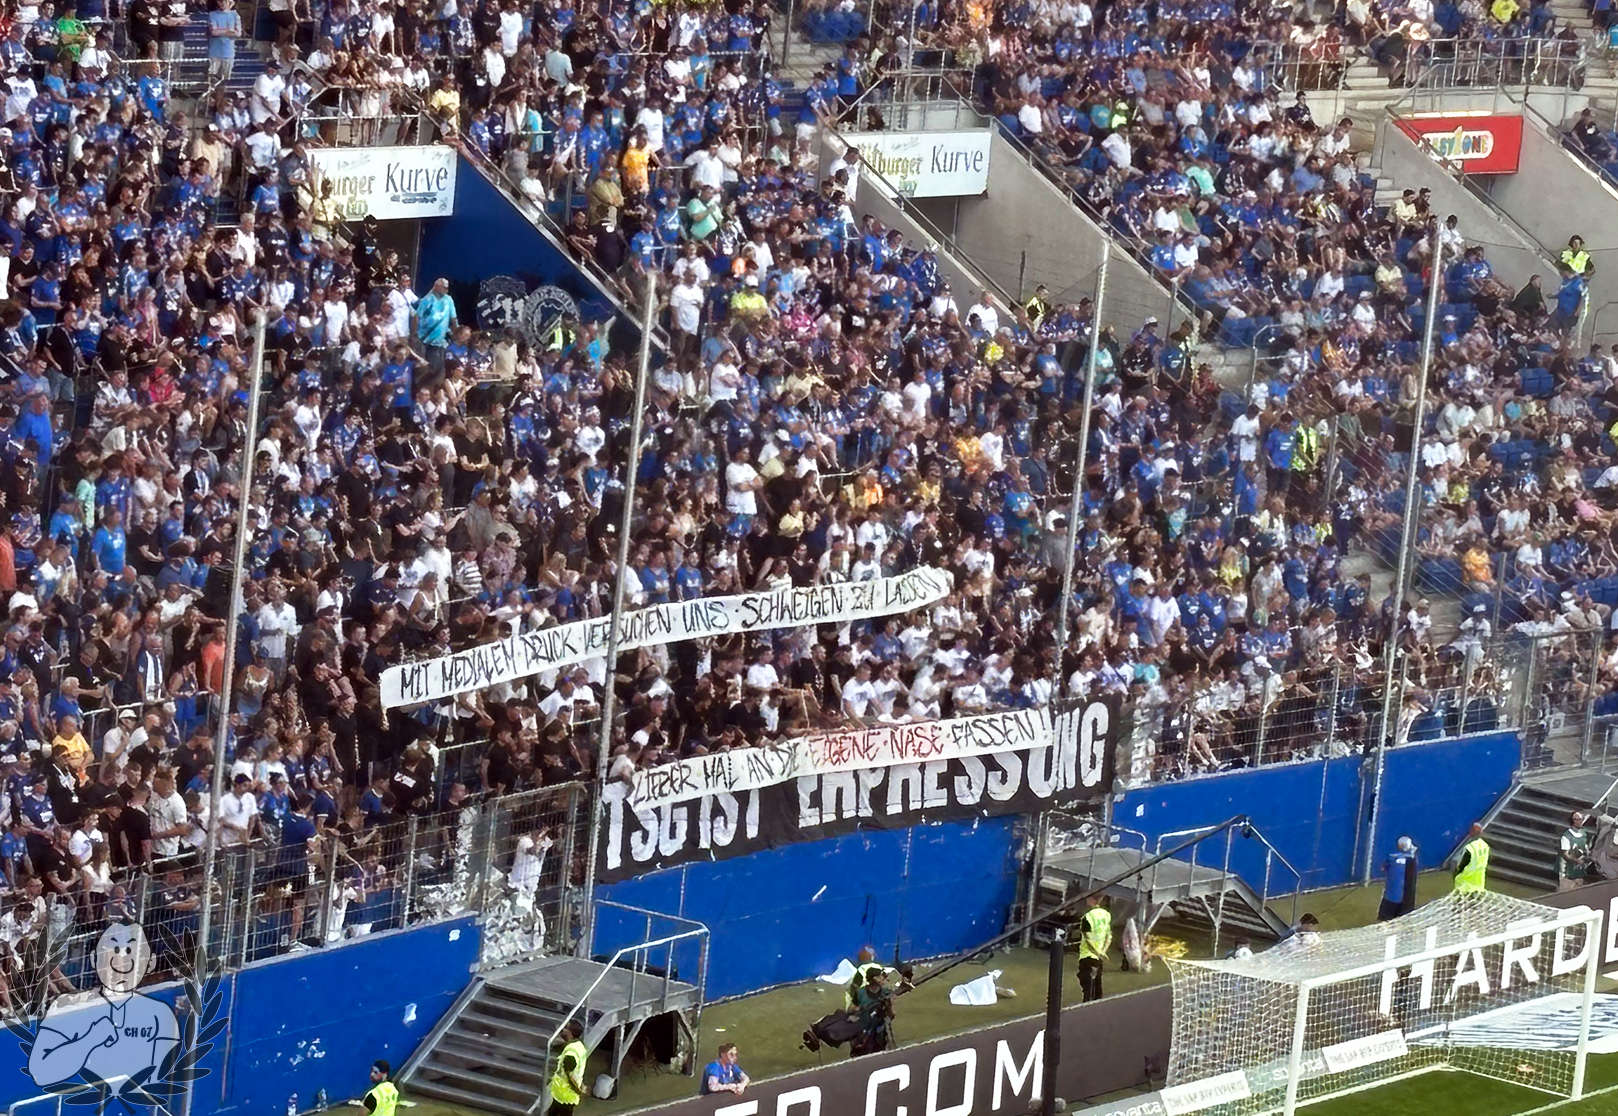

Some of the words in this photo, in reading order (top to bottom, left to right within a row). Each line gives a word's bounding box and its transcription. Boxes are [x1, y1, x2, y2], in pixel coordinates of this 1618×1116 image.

[385, 162, 449, 193] Kurve
[931, 144, 984, 174] Kurve
[400, 662, 430, 700] MIT
[441, 635, 518, 694] MEDIALEM
[519, 627, 579, 670] DRUCK
[681, 600, 730, 633] UNS
[741, 585, 843, 629] SCHWEIGEN
[851, 583, 875, 611] ZU
[632, 763, 699, 805] LIEBER
[703, 755, 740, 790] MAL
[746, 750, 775, 785] AN
[810, 732, 882, 766] EIGENE
[888, 725, 945, 760] NASE
